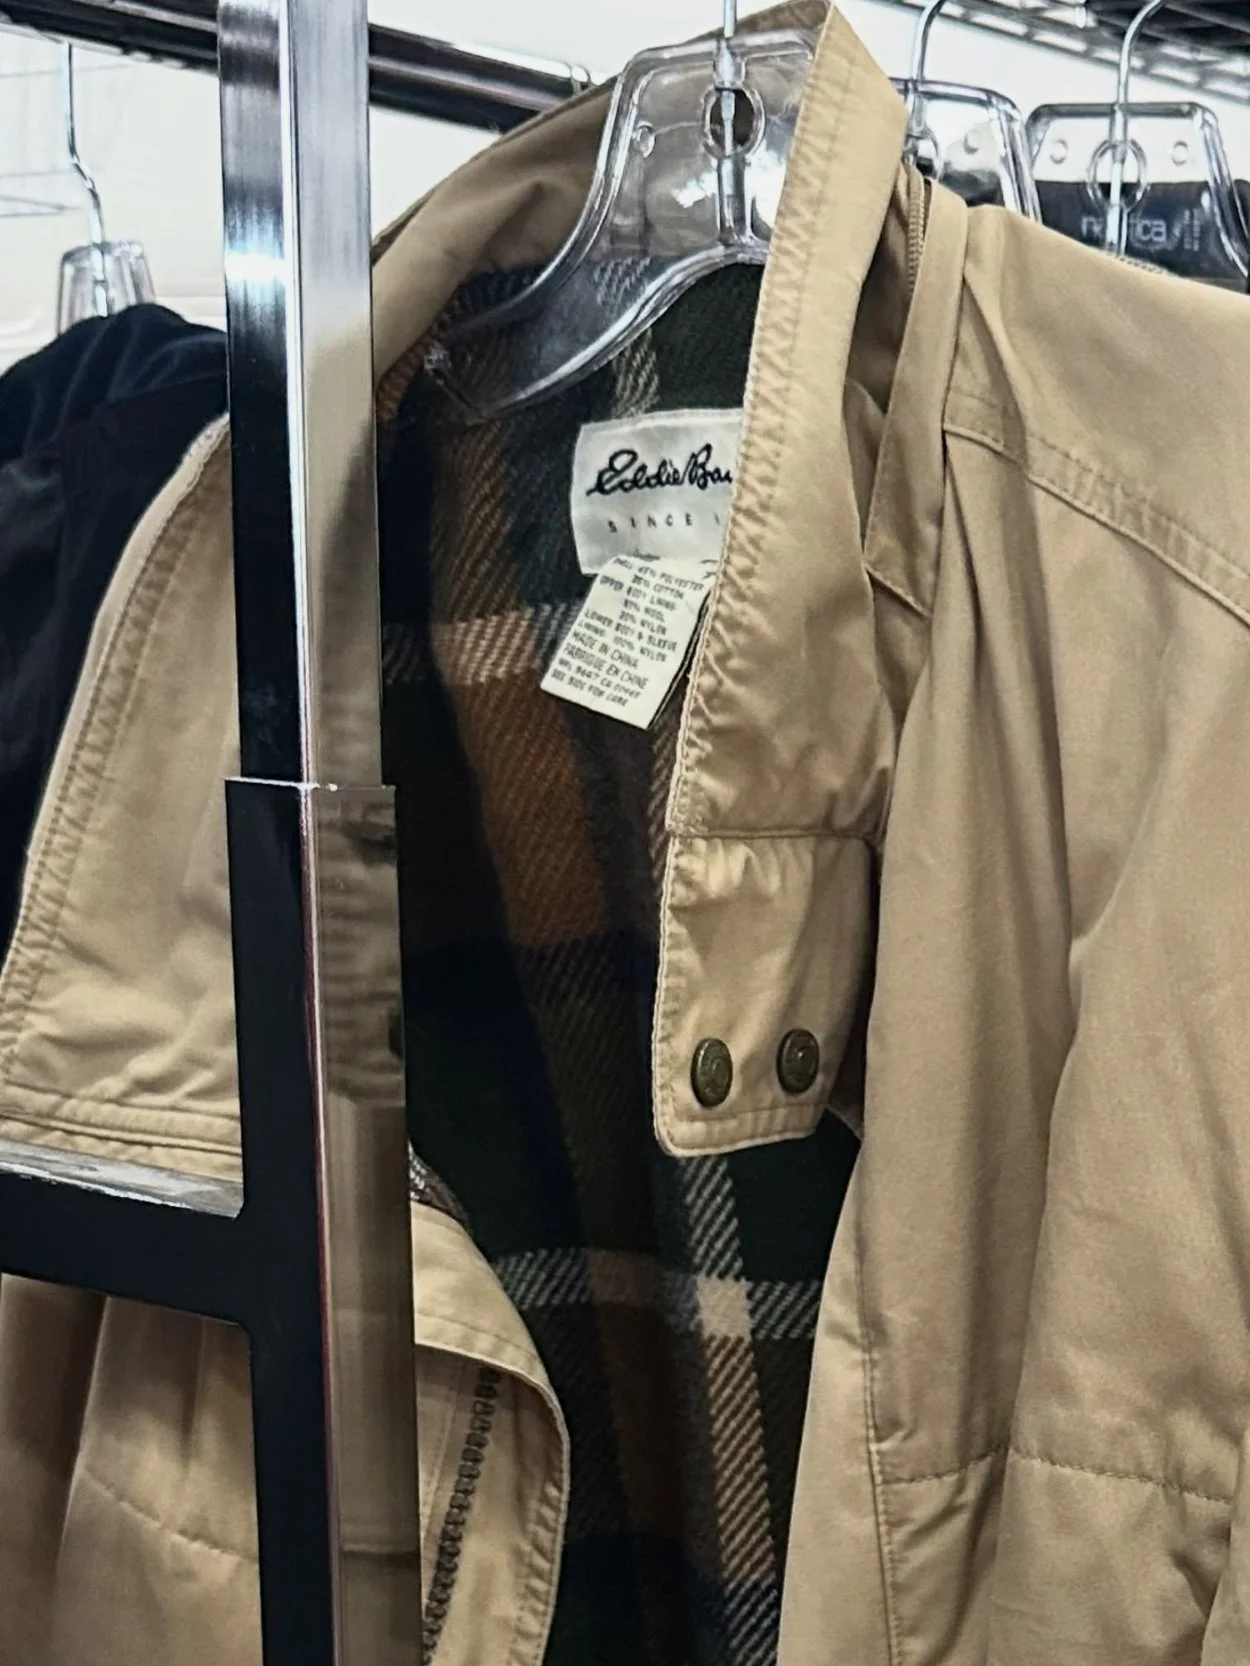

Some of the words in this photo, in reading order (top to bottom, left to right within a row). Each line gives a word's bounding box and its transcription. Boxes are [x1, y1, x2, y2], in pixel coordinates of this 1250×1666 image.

[586, 449, 684, 497] Eddie
[608, 512, 692, 533] SINCE
[653, 583, 684, 599] COTTON
[659, 572, 704, 592] POLYESTER
[584, 609, 614, 627] LOWER
[647, 634, 677, 652] SLEEVE
[640, 619, 667, 636] NYLON
[573, 630, 598, 649] MADE
[598, 642, 609, 655] IN
[610, 649, 639, 670] CHINA
[639, 646, 667, 662] NYLON
[565, 643, 607, 671] FABRIQUE
[606, 664, 621, 677] EN
[620, 671, 649, 689] CHINE
